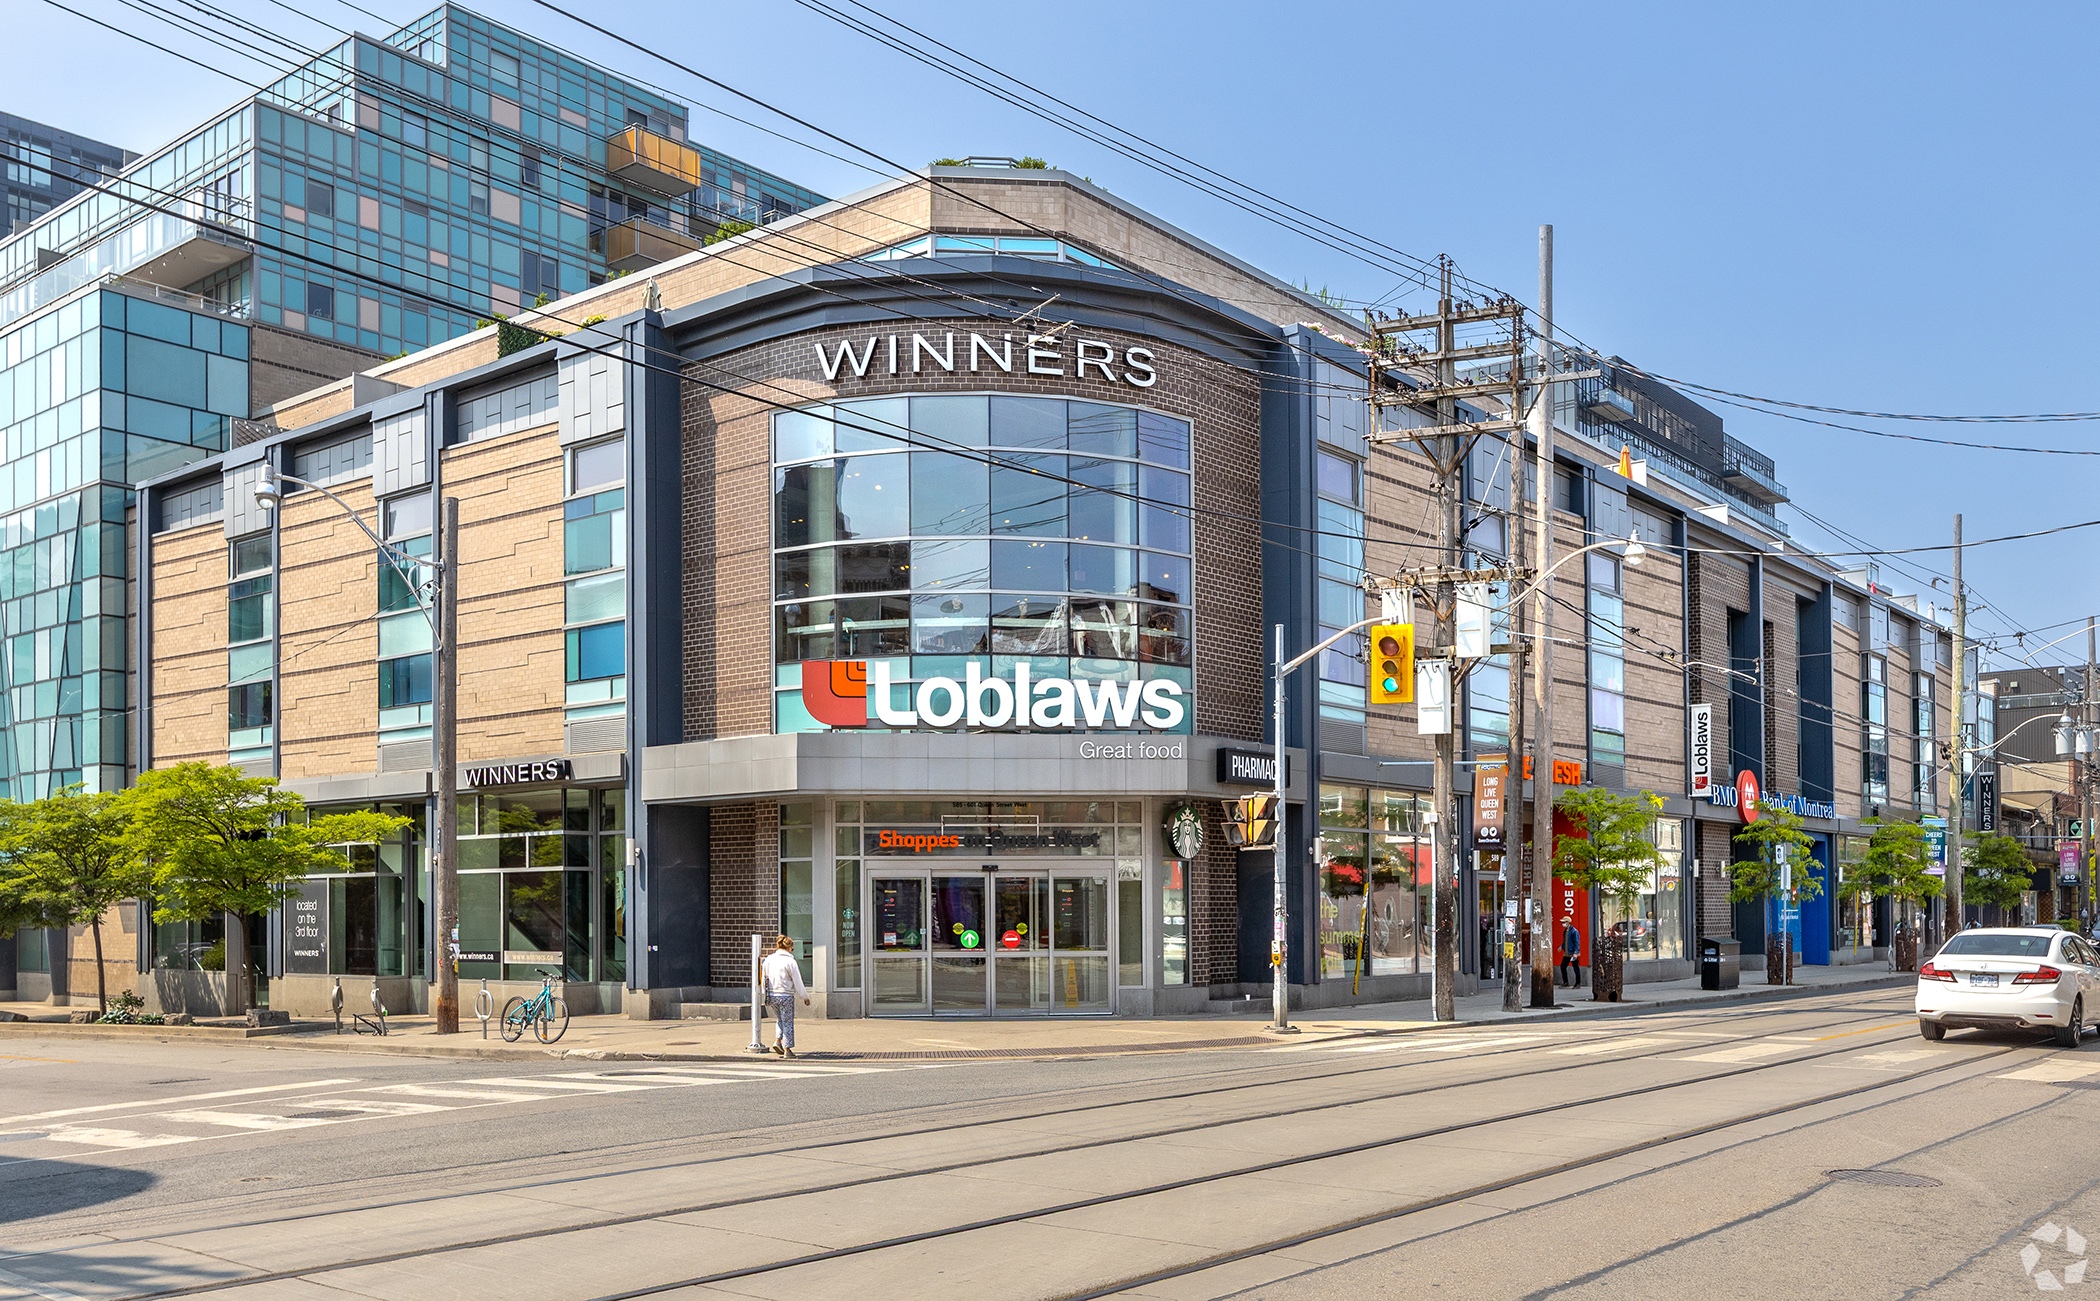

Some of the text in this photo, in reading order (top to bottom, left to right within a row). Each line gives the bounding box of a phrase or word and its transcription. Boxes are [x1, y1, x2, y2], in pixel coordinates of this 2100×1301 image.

[814, 332, 1158, 388] WINNERS
[875, 660, 1184, 729] Loblaws
[1079, 740, 1182, 760] Great food
[1694, 712, 1708, 775] Loblaws
[464, 761, 558, 787] WINNERS
[1232, 755, 1276, 781] PHARMAC
[1483, 777, 1499, 786] LONG
[1484, 788, 1496, 797] LIVE
[1712, 784, 1836, 820] BMO Bank of Montreal
[1981, 776, 1993, 830] WINNERS
[1480, 799, 1499, 808] QUEEN
[1482, 810, 1497, 819] WEST
[879, 830, 1100, 852] Shoppes on Queen West
[296, 900, 317, 910] located
[1564, 890, 1574, 915] JOE
[297, 913, 316, 924] on the
[295, 926, 318, 937] 3rd floor
[294, 949, 319, 957] WINNERS
